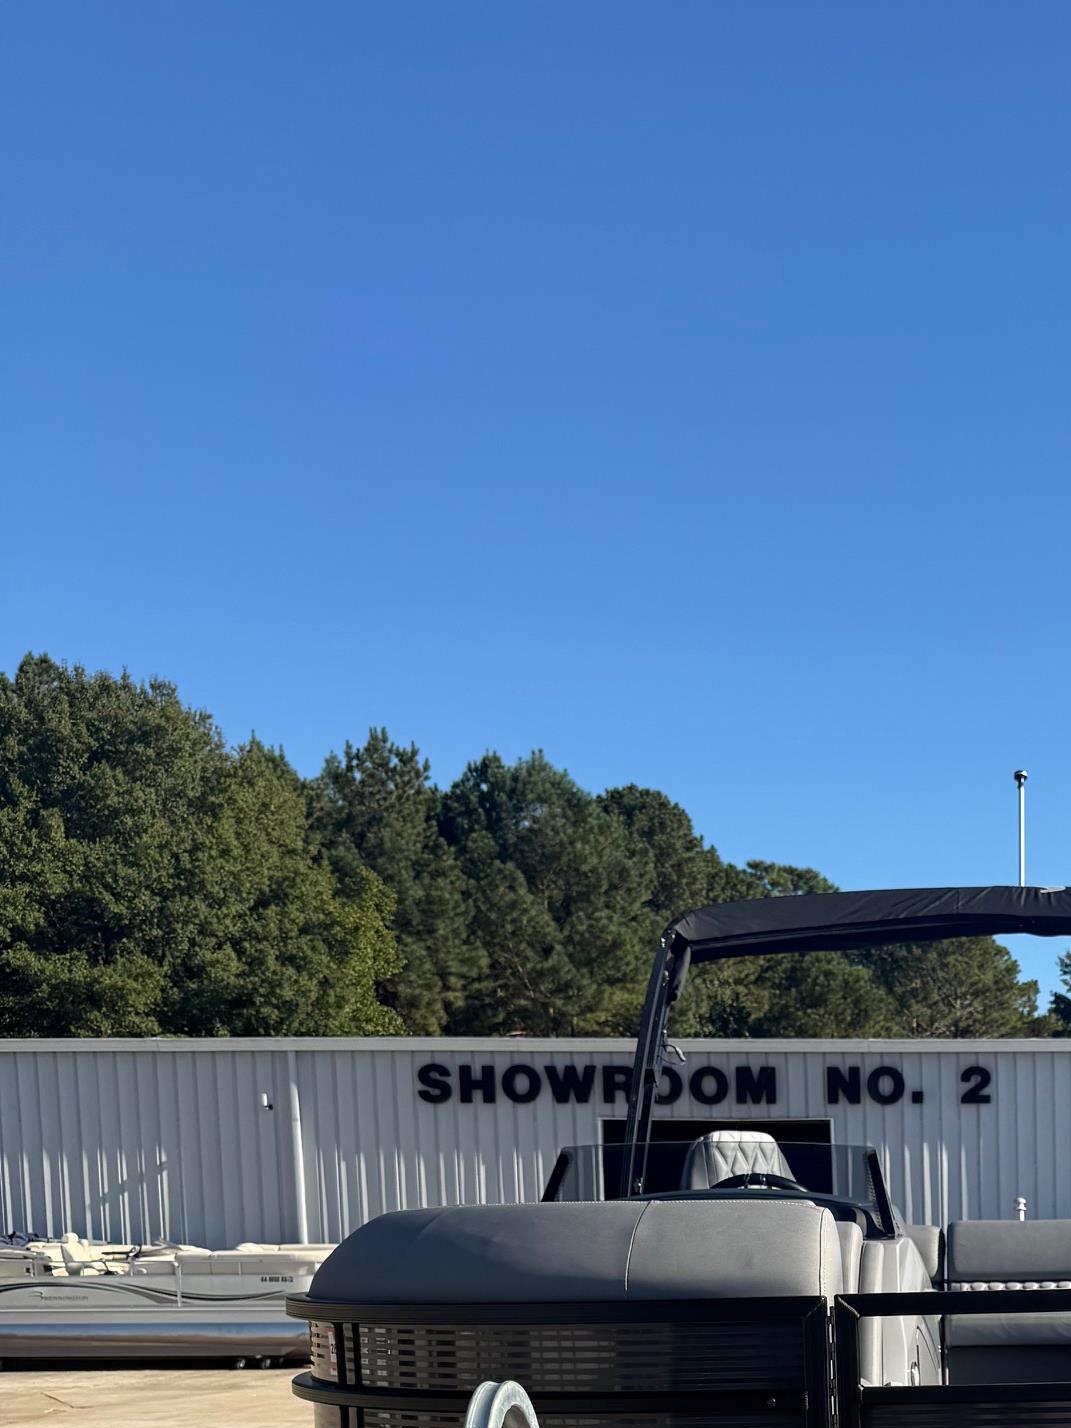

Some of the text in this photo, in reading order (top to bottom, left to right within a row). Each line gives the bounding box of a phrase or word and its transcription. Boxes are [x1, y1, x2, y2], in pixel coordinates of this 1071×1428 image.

[417, 1063, 993, 1105] SHOWROOM NO. 2
